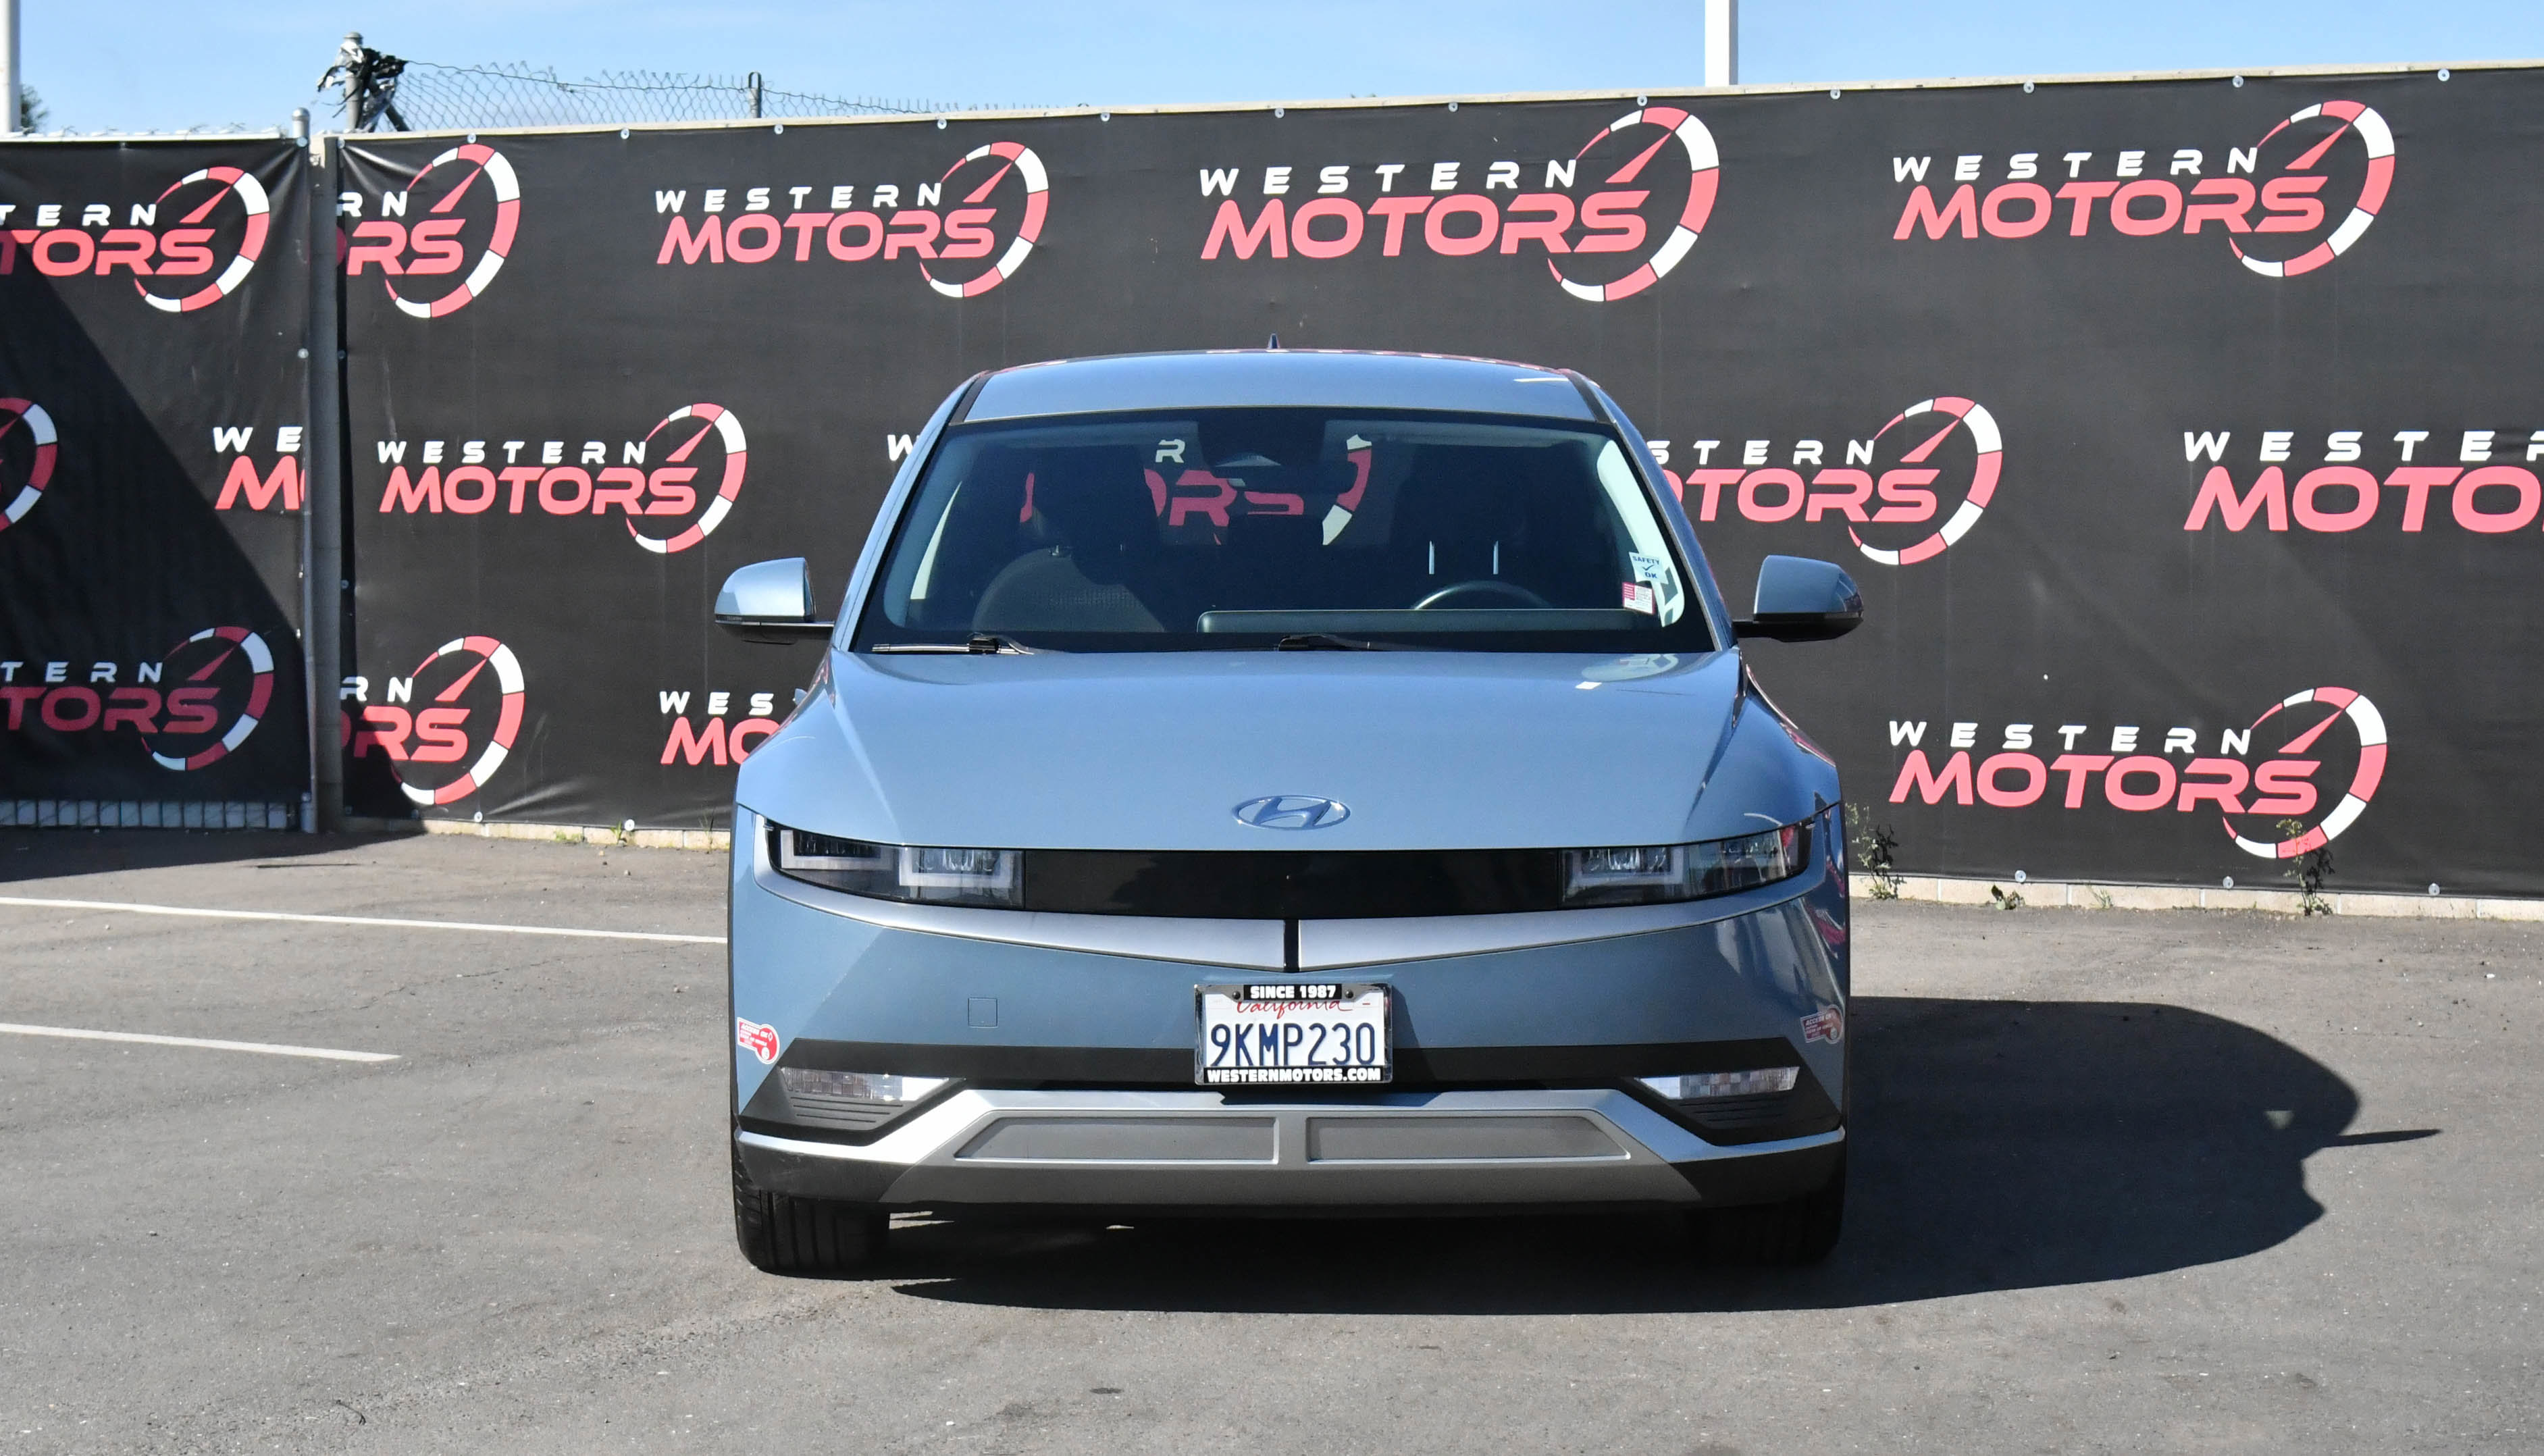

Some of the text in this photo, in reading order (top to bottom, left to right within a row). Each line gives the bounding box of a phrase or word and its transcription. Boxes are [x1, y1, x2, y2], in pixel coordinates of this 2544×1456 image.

[1200, 159, 1577, 197] WESTERN
[1893, 147, 2258, 182] WESTERN
[656, 182, 942, 213] WESTERN
[1893, 176, 2329, 240] MOTORS
[657, 208, 997, 265] MOTORS
[1201, 190, 1651, 259] MOTORS
[378, 441, 646, 464] WESTERN
[379, 465, 698, 516] MOTORS
[2183, 465, 2544, 534] MOTO
[1632, 556, 1659, 565] SAFETY
[1889, 720, 2252, 755] WESTERN
[1889, 749, 2321, 816] MOTORS
[1250, 985, 1336, 999] SINCE 1987
[1210, 1022, 1376, 1066] 9KMP230
[1207, 1068, 1381, 1083] WESTERNMOTORS.COM
